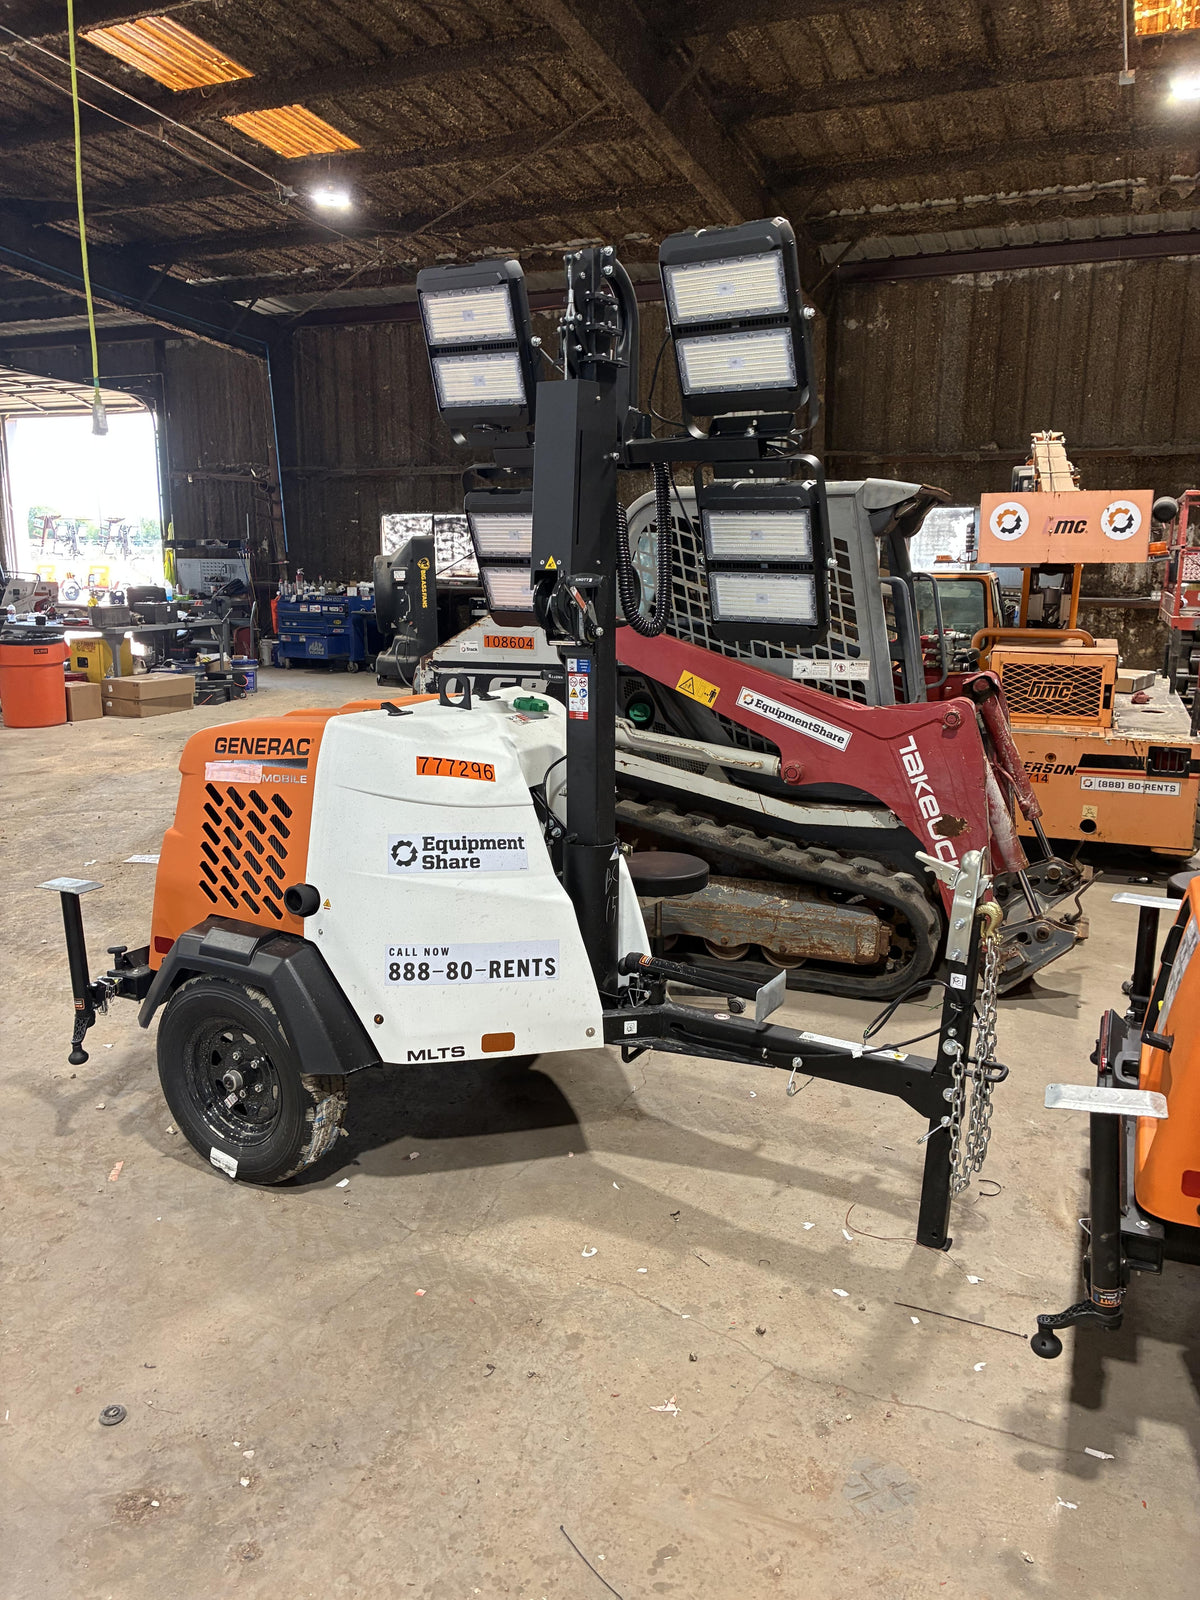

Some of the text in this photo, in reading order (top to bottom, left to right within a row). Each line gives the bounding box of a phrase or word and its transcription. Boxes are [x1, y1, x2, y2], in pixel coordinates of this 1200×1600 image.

[485, 635, 534, 649] 108604
[754, 698, 845, 744] EquipmentShare
[214, 737, 310, 756] GENERAC
[418, 757, 494, 781] 777296
[1024, 761, 1077, 776] ERSON
[261, 774, 308, 784] MOBILE
[1026, 772, 1049, 783] 714
[1097, 780, 1177, 793] (888) 80-RENTS
[898, 735, 960, 869] TAKEUC
[421, 835, 526, 854] Equipment
[421, 854, 481, 870] Share
[388, 947, 450, 957] CALL NOW
[388, 957, 558, 982] 888-80-RENTS
[407, 1045, 466, 1062] MLTS
